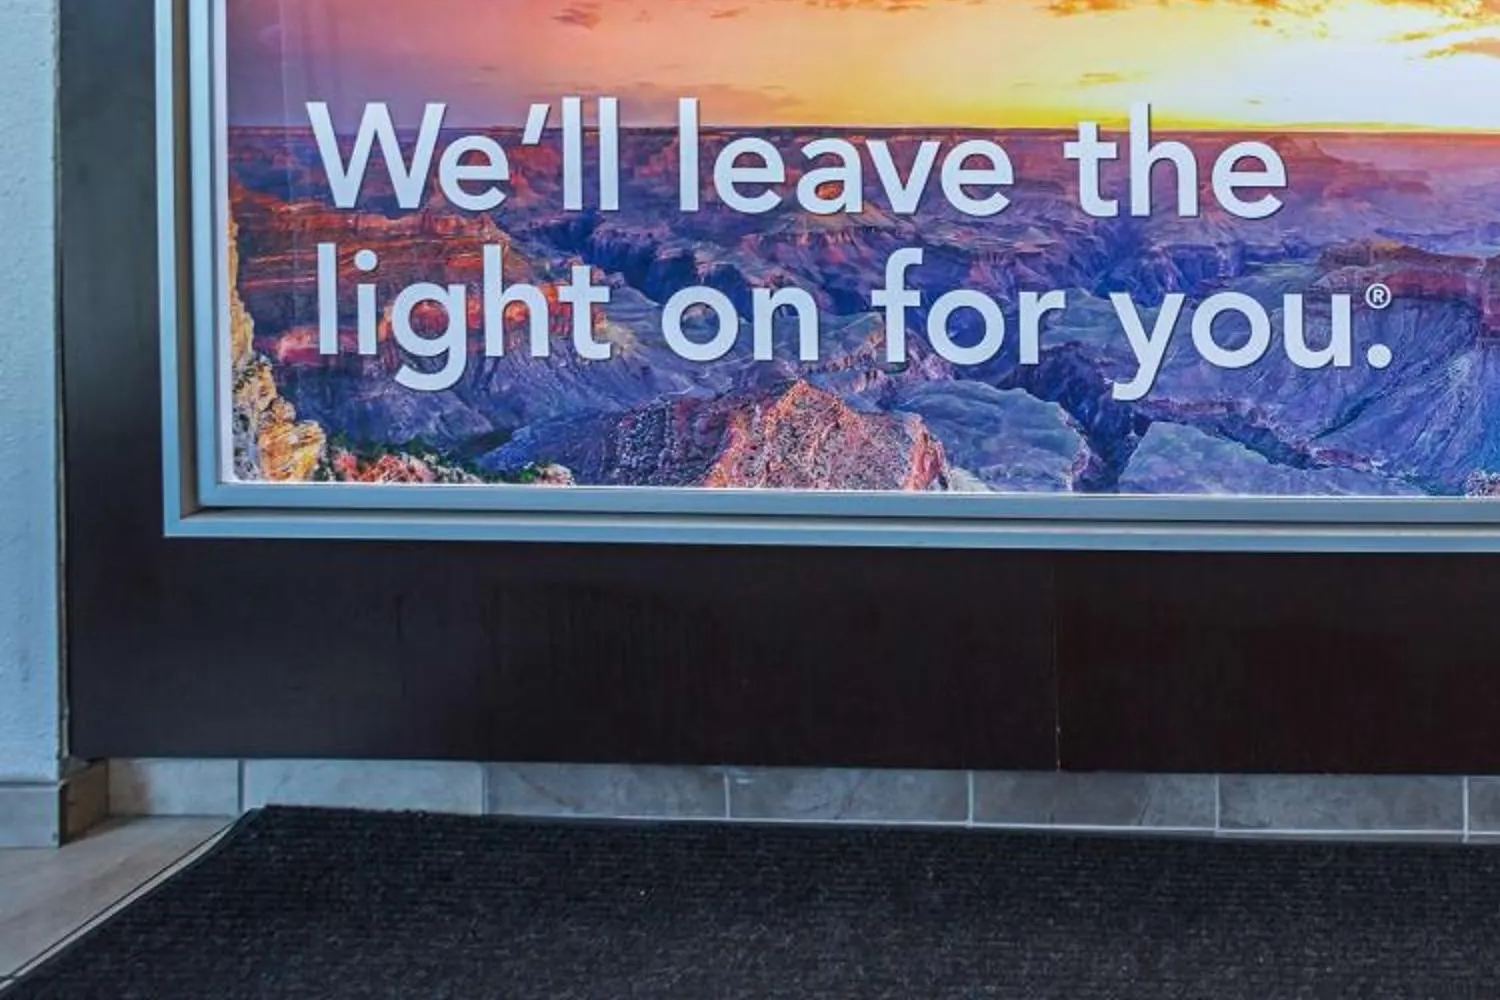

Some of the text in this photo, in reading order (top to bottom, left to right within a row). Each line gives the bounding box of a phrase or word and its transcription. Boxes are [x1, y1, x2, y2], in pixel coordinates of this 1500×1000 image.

[305, 95, 1288, 219] We'll leave the
[315, 242, 612, 392] light
[661, 283, 820, 362] on
[871, 248, 1066, 366] for
